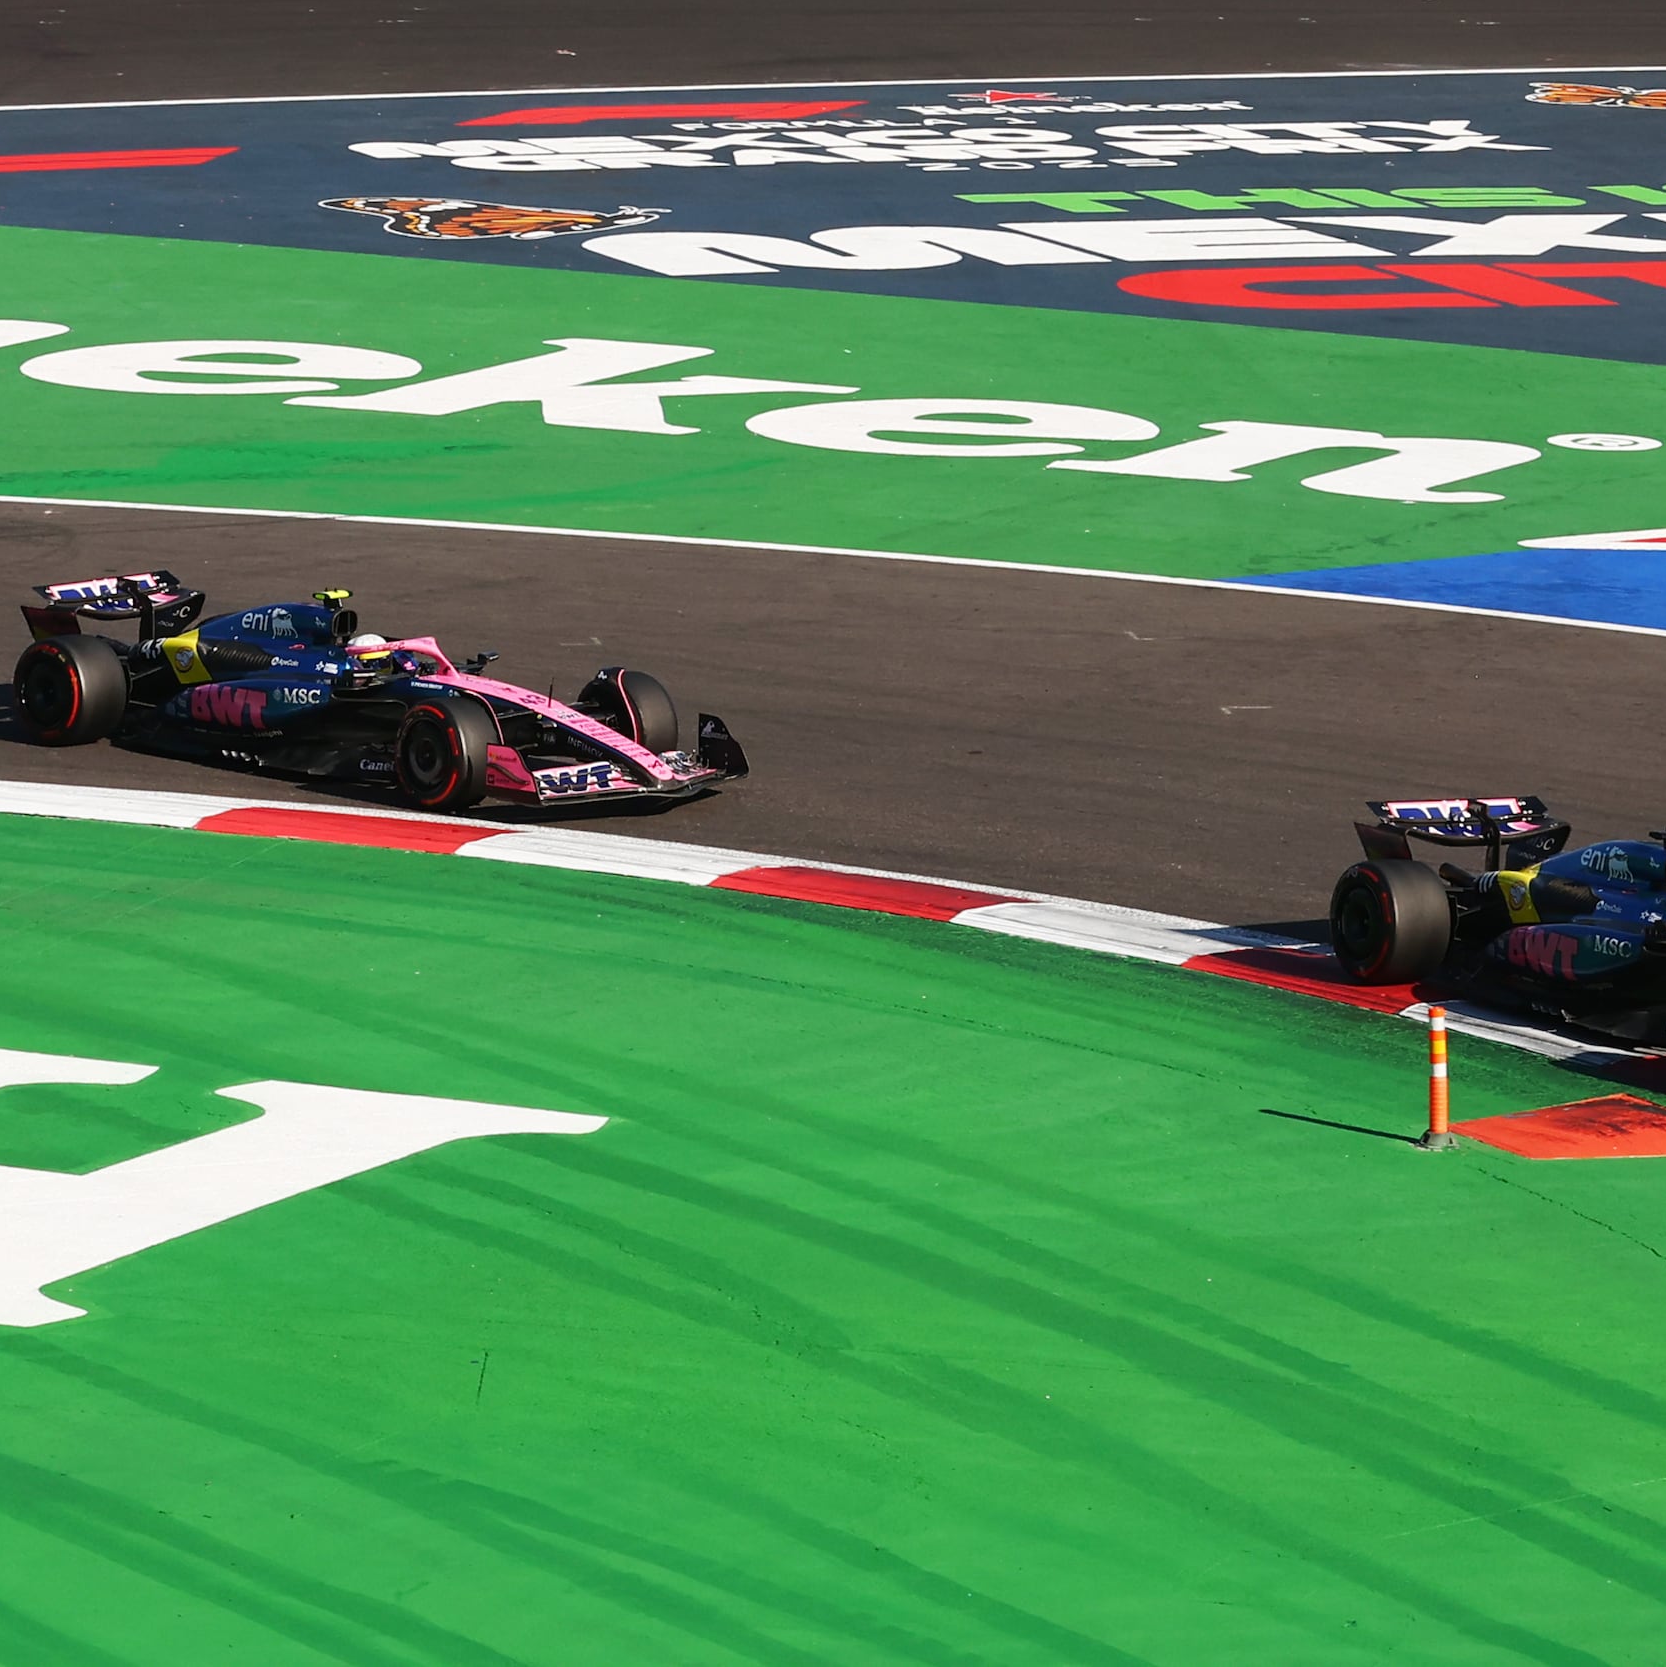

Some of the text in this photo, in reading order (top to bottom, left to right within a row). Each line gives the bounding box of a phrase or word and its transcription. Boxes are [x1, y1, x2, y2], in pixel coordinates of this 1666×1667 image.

[897, 100, 1253, 119] Heineken
[672, 118, 967, 132] FORMULA
[347, 120, 1487, 160] MEXICO CITY
[450, 134, 1553, 174] GRAND PRIX
[905, 158, 1179, 172] 2025
[953, 186, 1587, 214] THIS
[241, 612, 270, 632] eni
[140, 637, 163, 660] 43
[191, 684, 267, 728] BWT
[283, 687, 321, 705] MSC
[567, 735, 605, 758] INFINOX
[1581, 846, 1607, 870] eni
[1508, 928, 1579, 981] BWT
[1594, 935, 1633, 958] MSC
